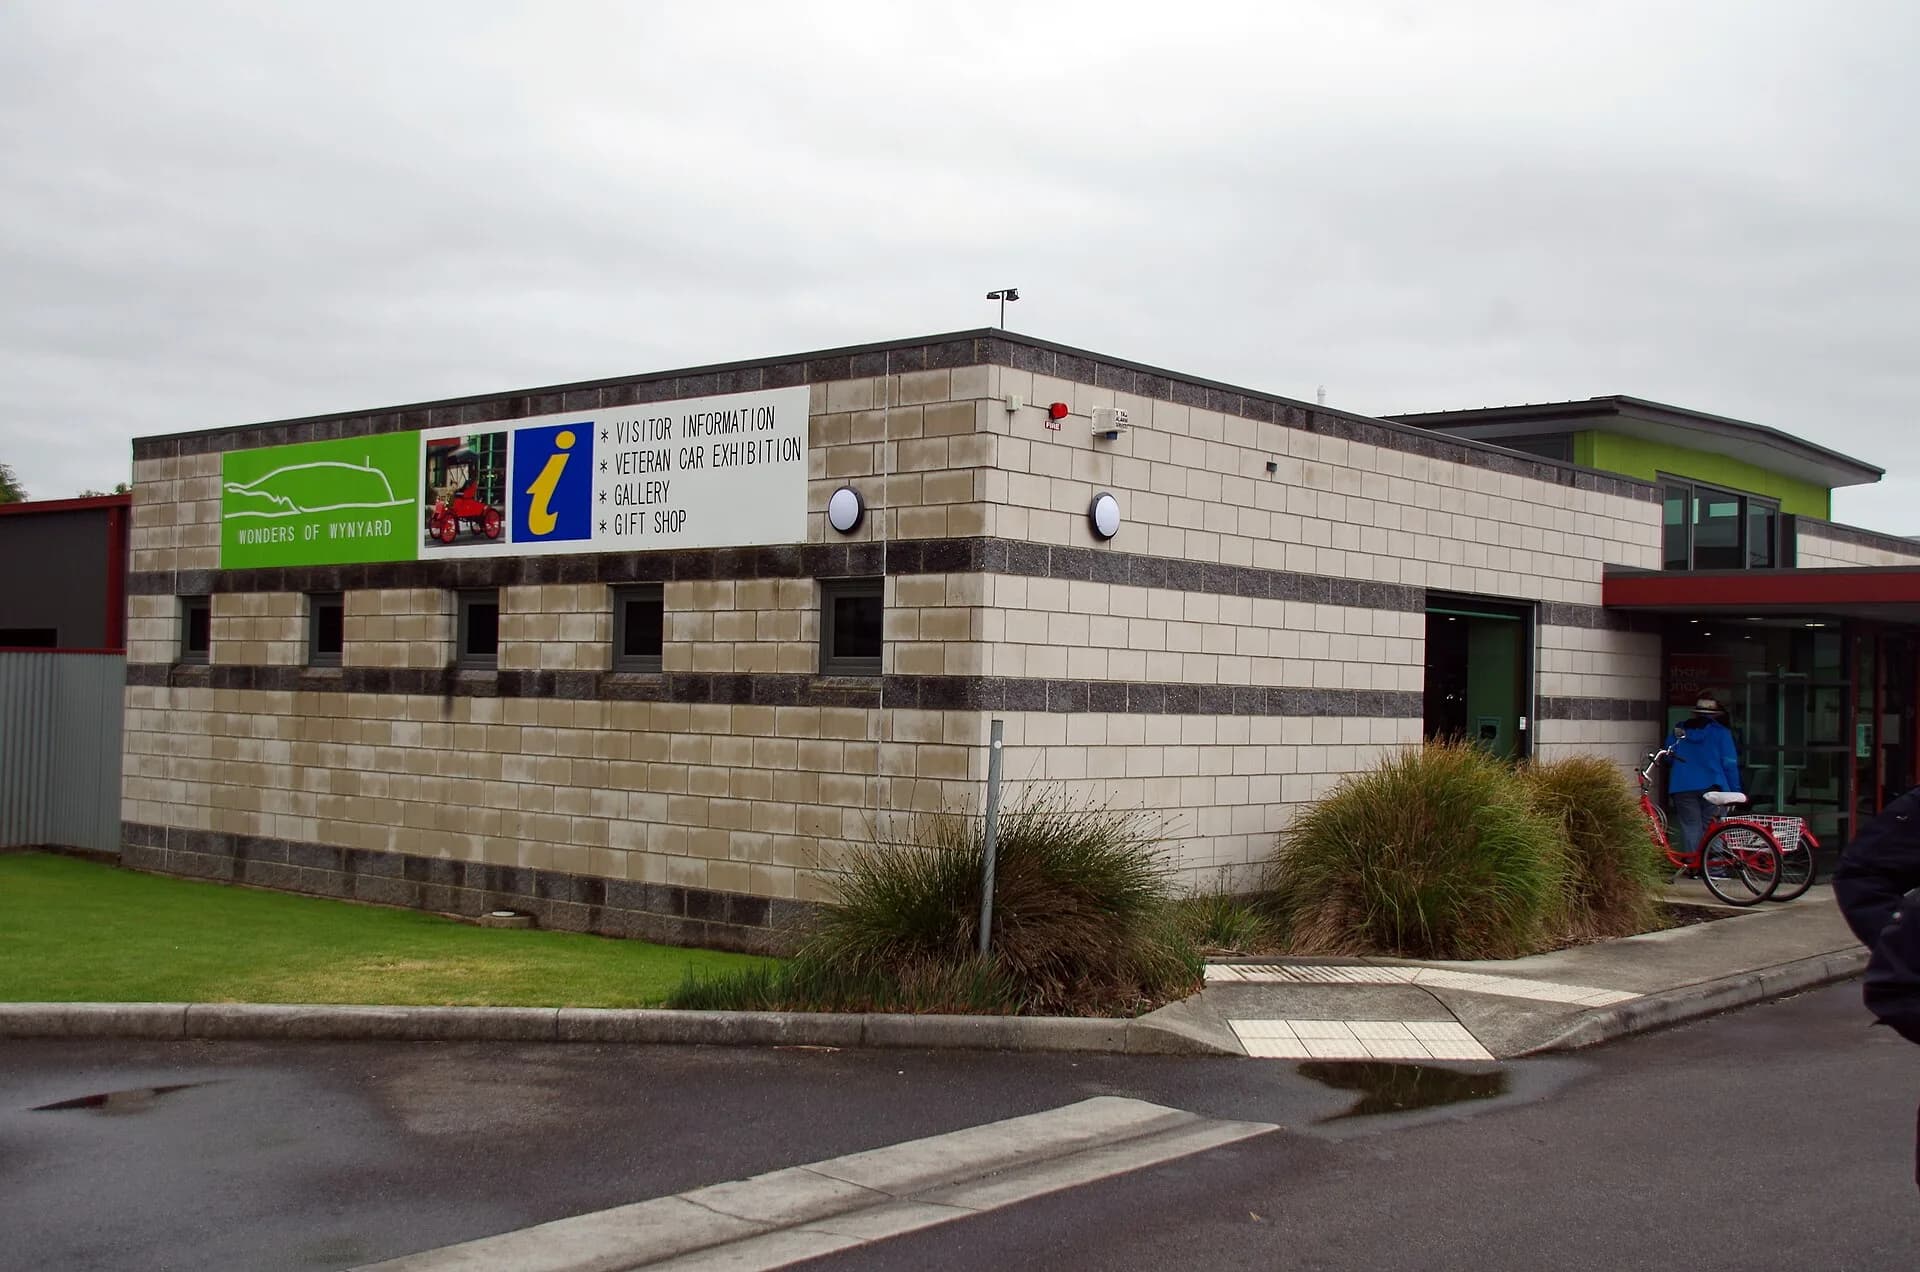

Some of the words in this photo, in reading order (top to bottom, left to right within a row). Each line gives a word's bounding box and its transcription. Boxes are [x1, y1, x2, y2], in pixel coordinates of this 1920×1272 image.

[617, 417, 672, 444] VISITOR
[682, 406, 775, 438] INFORMATION
[1045, 421, 1060, 430] FIRE
[615, 448, 671, 475] VETERAN
[679, 446, 704, 470] CAR
[712, 436, 801, 467] EXHIBITION
[614, 480, 670, 506] GALLERY
[239, 526, 295, 545] WONDERS
[304, 524, 321, 541] OF
[330, 519, 393, 539] WYNYARD
[614, 512, 646, 535] GIFT
[654, 509, 687, 533] SHOP
